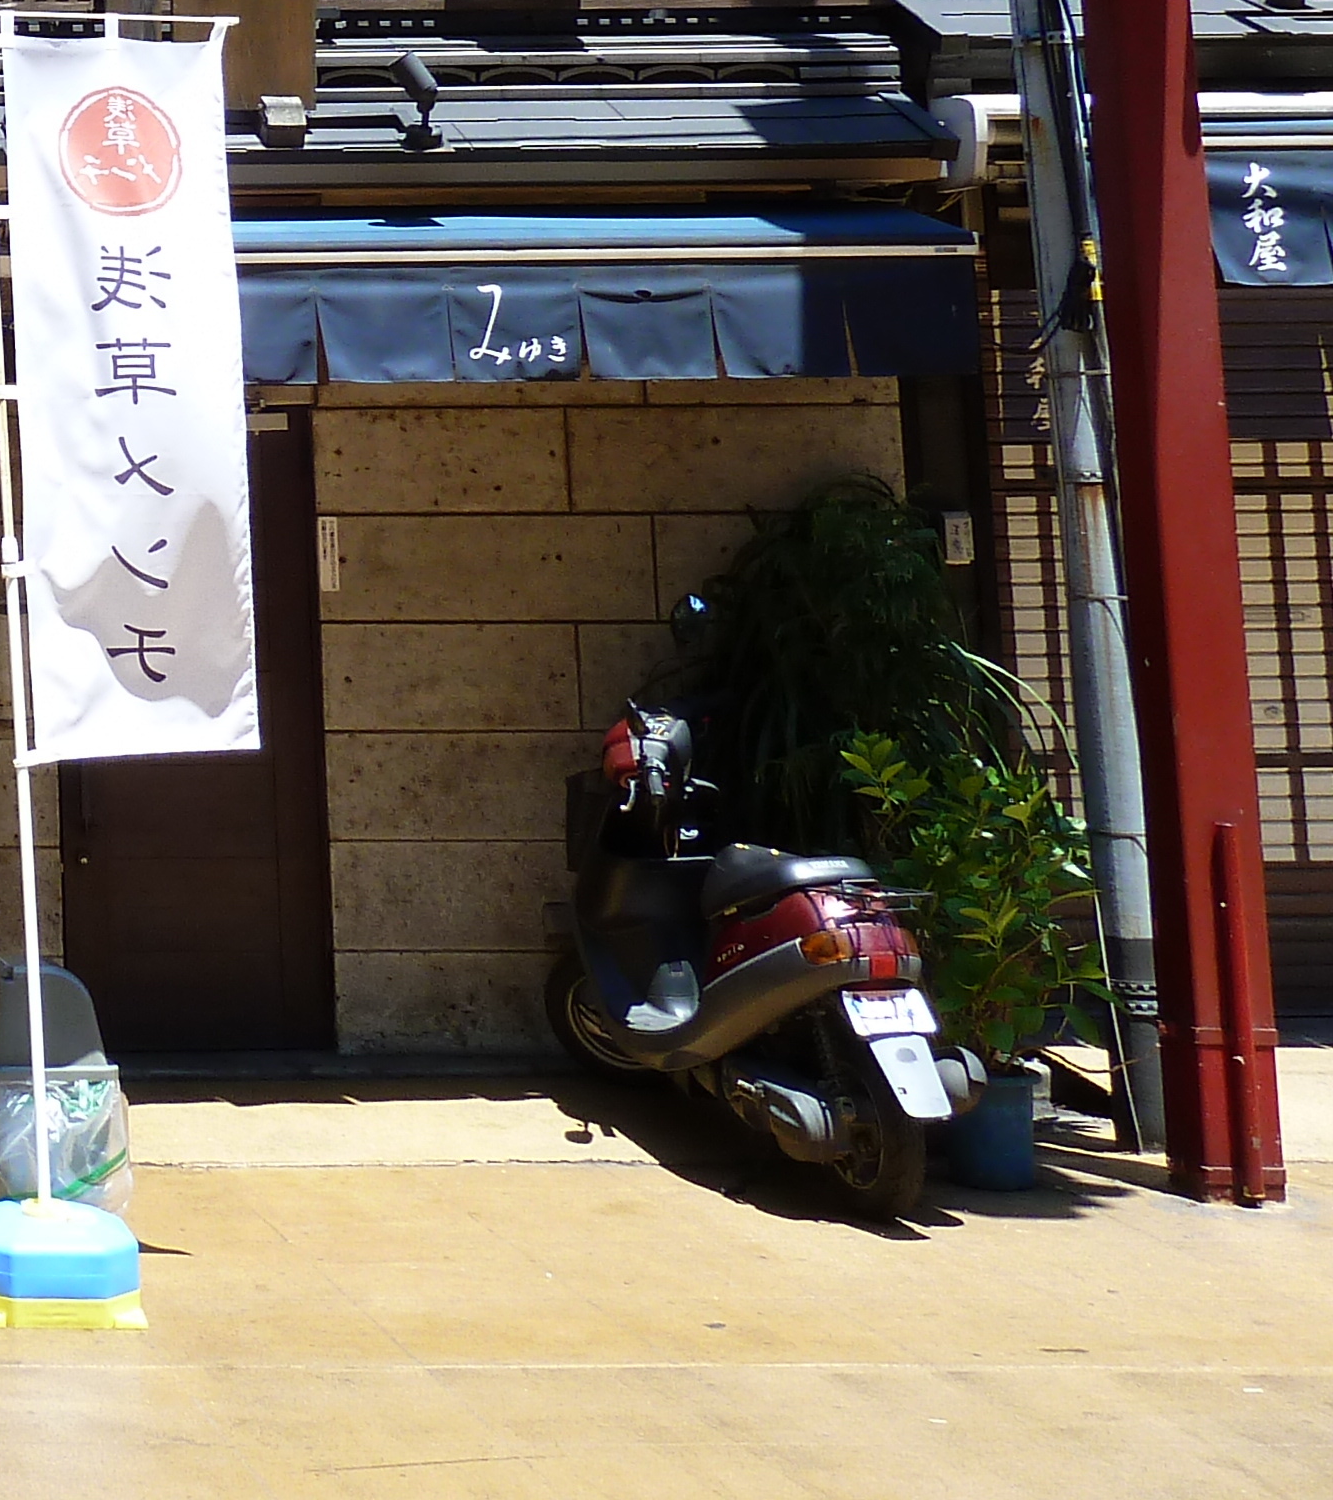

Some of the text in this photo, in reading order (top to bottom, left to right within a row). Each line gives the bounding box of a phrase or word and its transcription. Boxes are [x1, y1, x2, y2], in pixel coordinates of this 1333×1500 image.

[1241, 162, 1287, 271] 大和屋
[469, 284, 568, 365] みゆき
